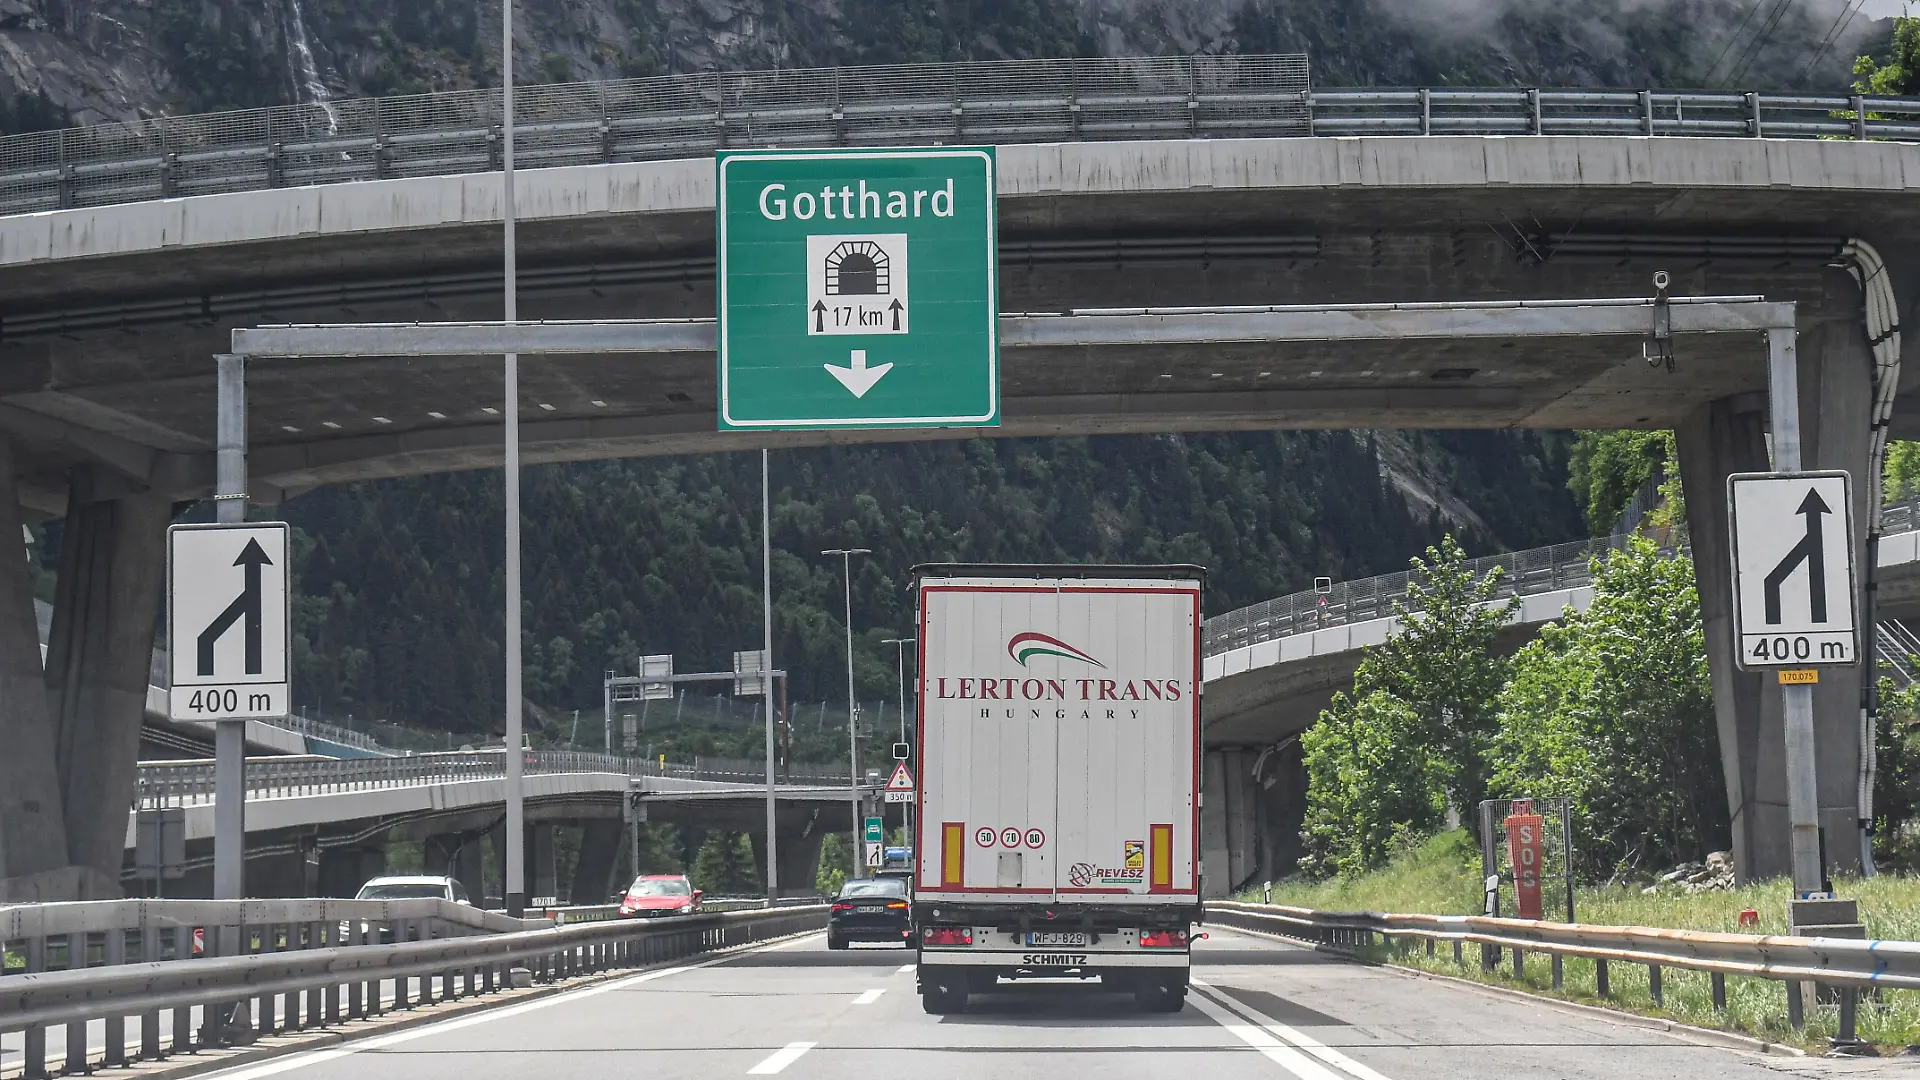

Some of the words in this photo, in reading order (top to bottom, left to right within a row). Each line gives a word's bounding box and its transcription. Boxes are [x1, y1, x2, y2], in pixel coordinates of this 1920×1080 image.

[759, 178, 955, 221] Gotthard
[833, 306, 852, 327] 17
[859, 304, 883, 326] km
[1752, 636, 1810, 660] 400
[1820, 641, 1845, 659] m
[1783, 672, 1814, 681] 170.075
[936, 677, 1067, 701] LERTON
[1075, 679, 1182, 702] TRANS
[188, 688, 238, 713] 400
[248, 693, 271, 712] m
[980, 708, 1140, 719] HUNGARY
[890, 792, 905, 801] 350
[981, 832, 992, 842] 50
[1005, 832, 1017, 843] 70
[1029, 834, 1040, 844] 80
[1519, 825, 1536, 888] SOS
[1096, 868, 1144, 878] REVESZ
[1034, 933, 1083, 944] WFJ-829
[1022, 954, 1087, 965] SCHMITZ
